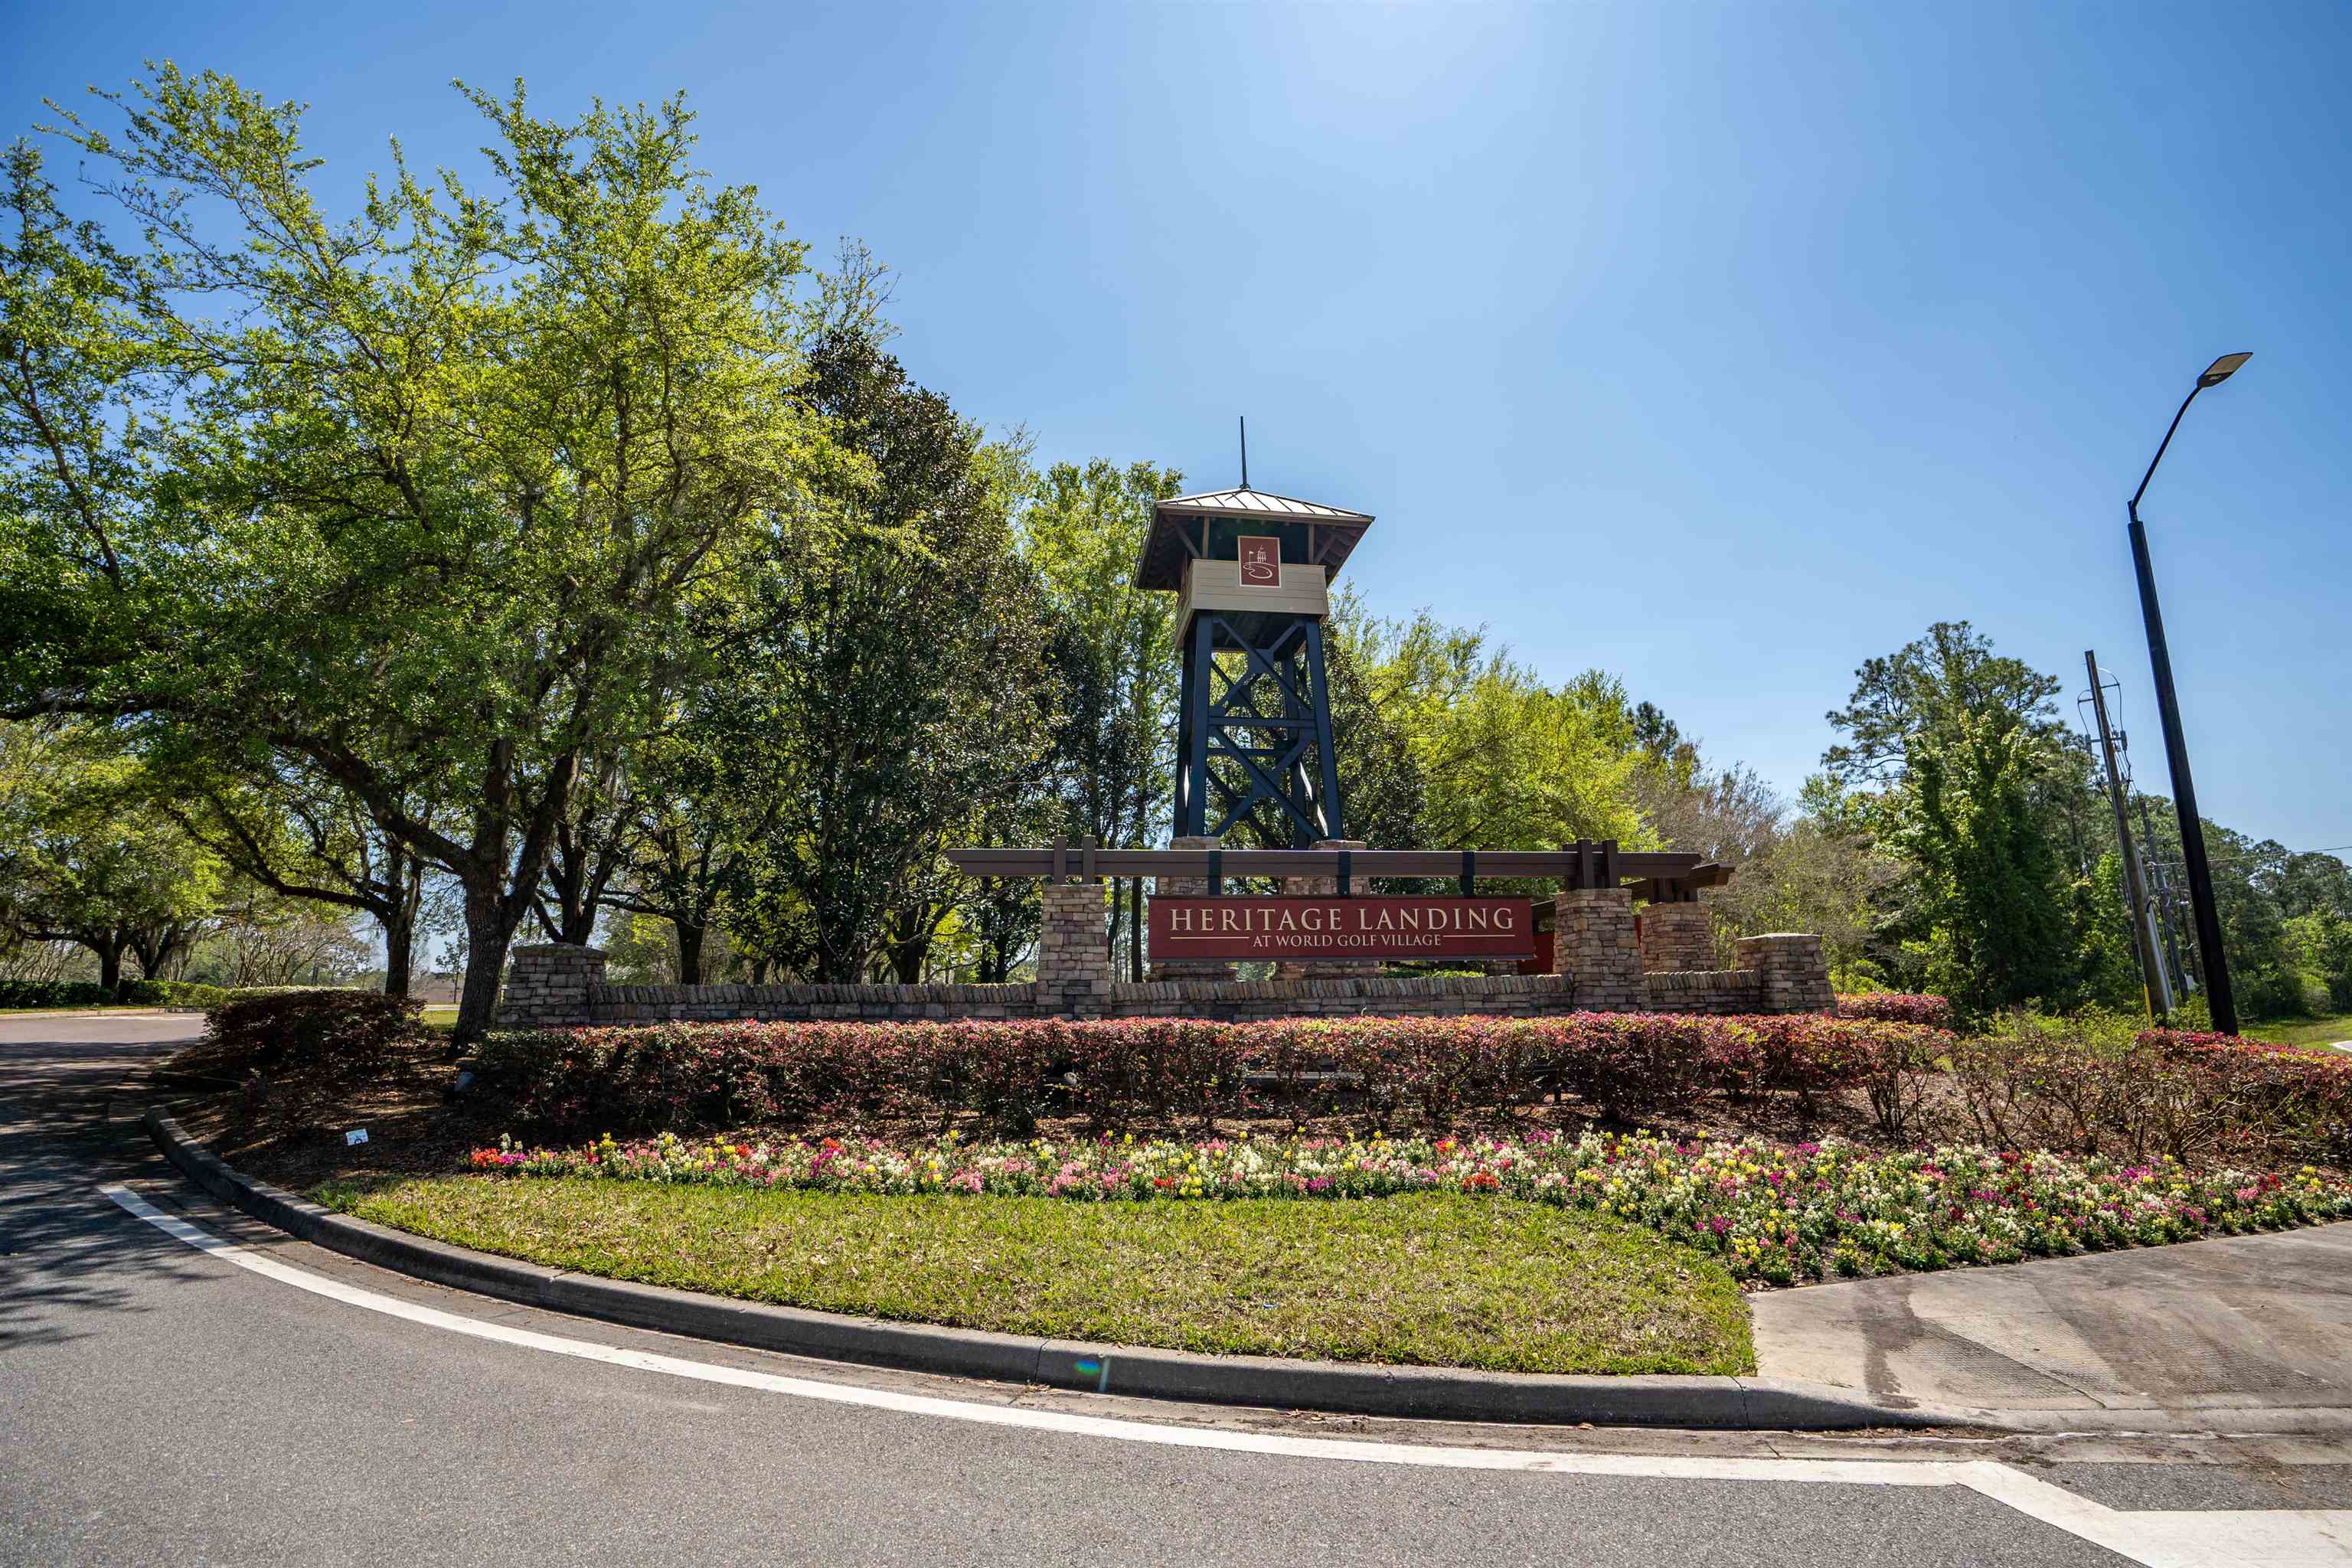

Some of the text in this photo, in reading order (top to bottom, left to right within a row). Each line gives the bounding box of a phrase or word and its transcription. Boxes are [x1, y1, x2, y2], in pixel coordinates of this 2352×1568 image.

[1170, 907, 1514, 931] HERITAGE LANDING
[1253, 934, 1442, 947] AT WORLD GOLF VILLAGE
